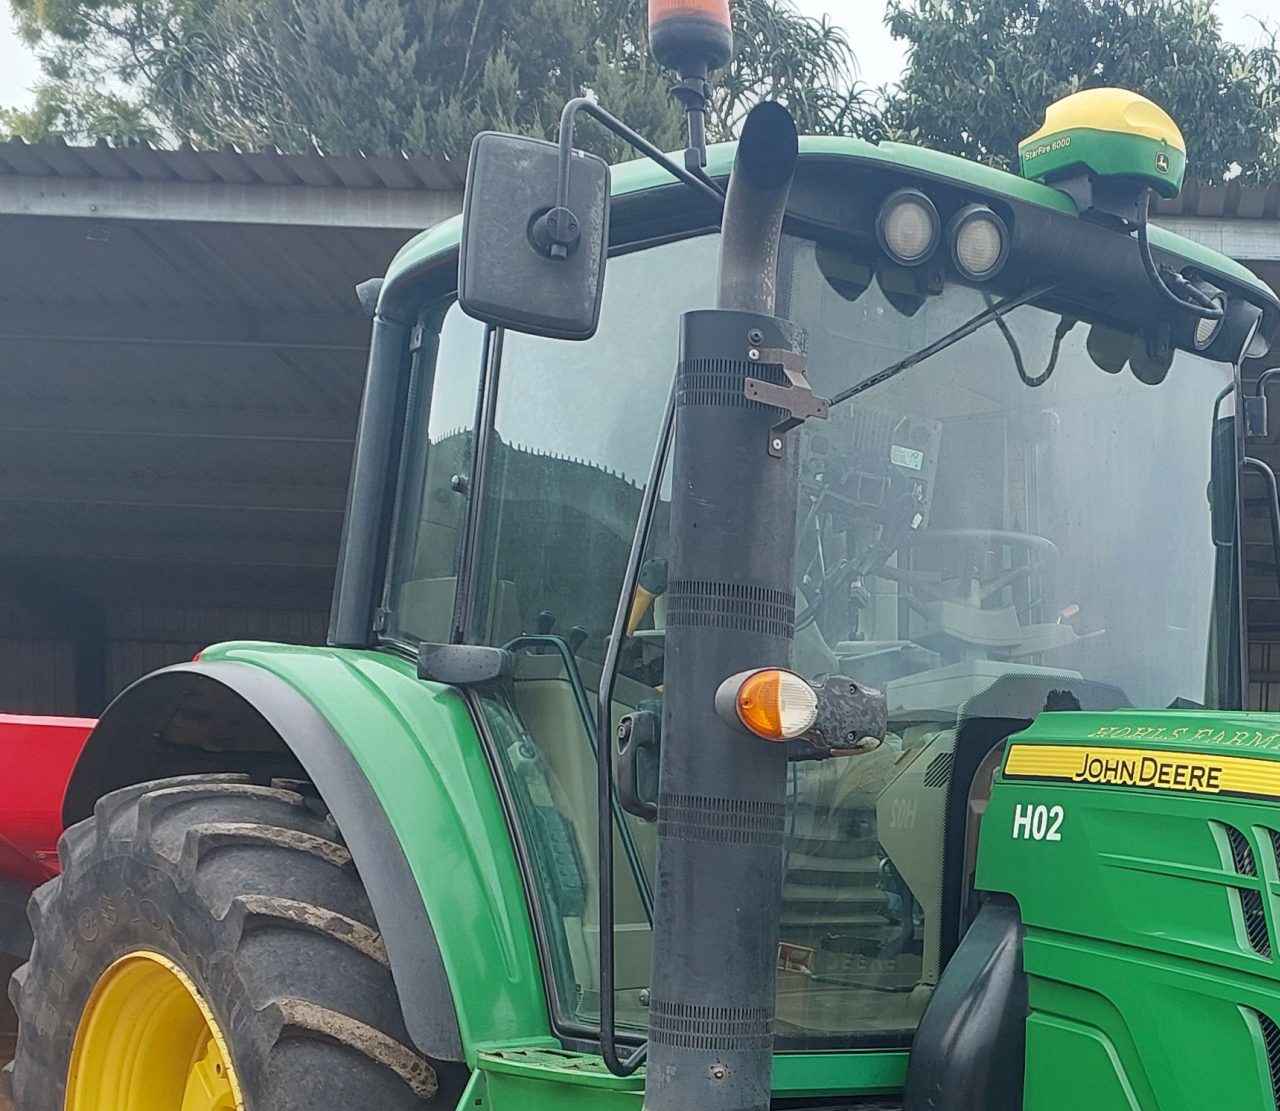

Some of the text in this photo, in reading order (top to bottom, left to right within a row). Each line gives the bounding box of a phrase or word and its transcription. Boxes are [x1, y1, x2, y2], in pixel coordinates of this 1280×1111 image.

[1025, 136, 1071, 161] StarFire 6000
[1075, 753, 1223, 789] JOHN DEERE
[1012, 804, 1064, 841] H02
